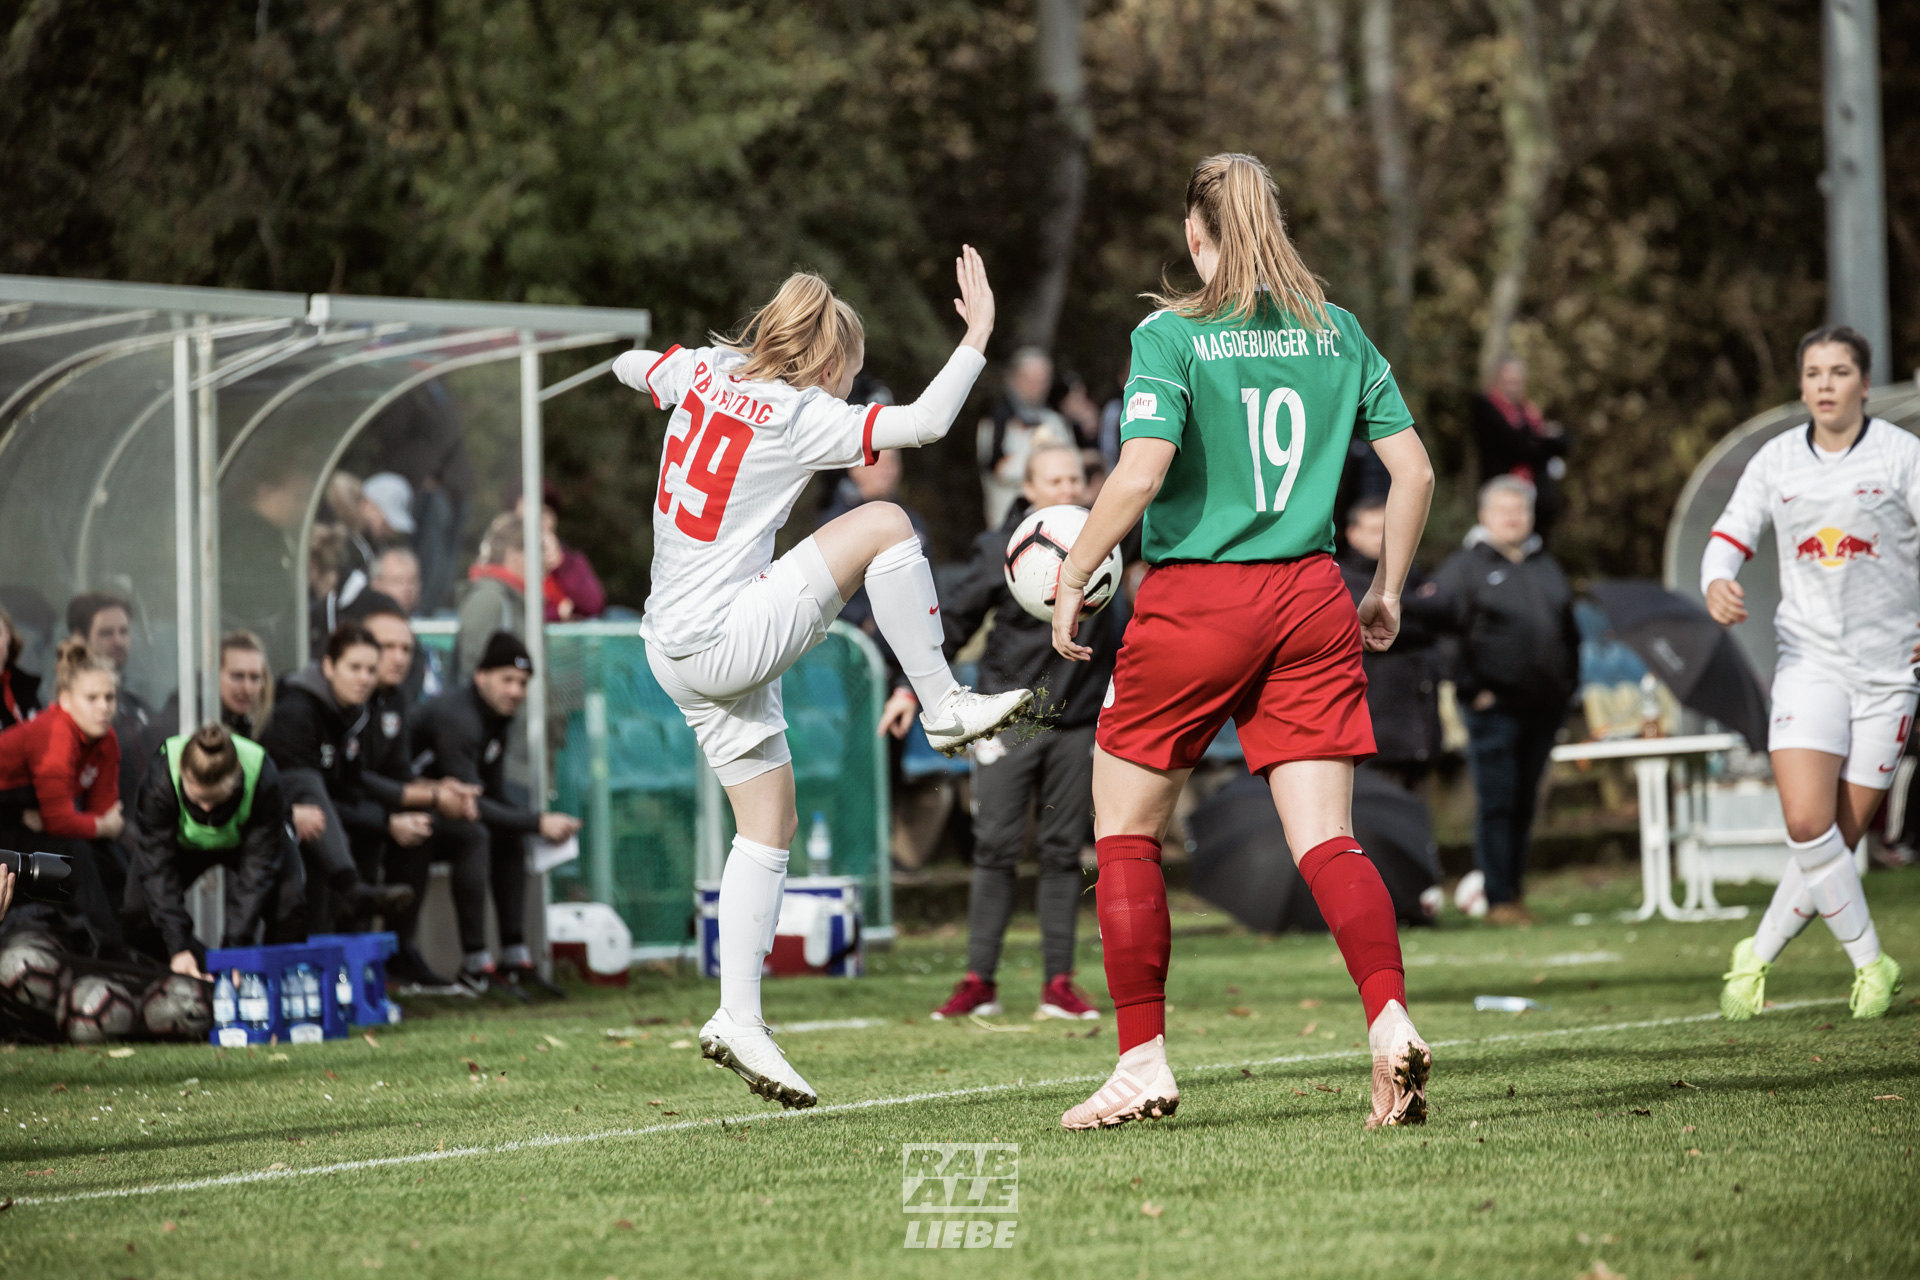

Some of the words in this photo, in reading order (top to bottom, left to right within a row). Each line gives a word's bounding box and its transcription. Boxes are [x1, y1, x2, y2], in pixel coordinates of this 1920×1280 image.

[1192, 328, 1310, 361] MAGDEBURGER
[1316, 328, 1341, 357] FFC
[658, 389, 754, 542] 29
[1241, 387, 1306, 512] 19
